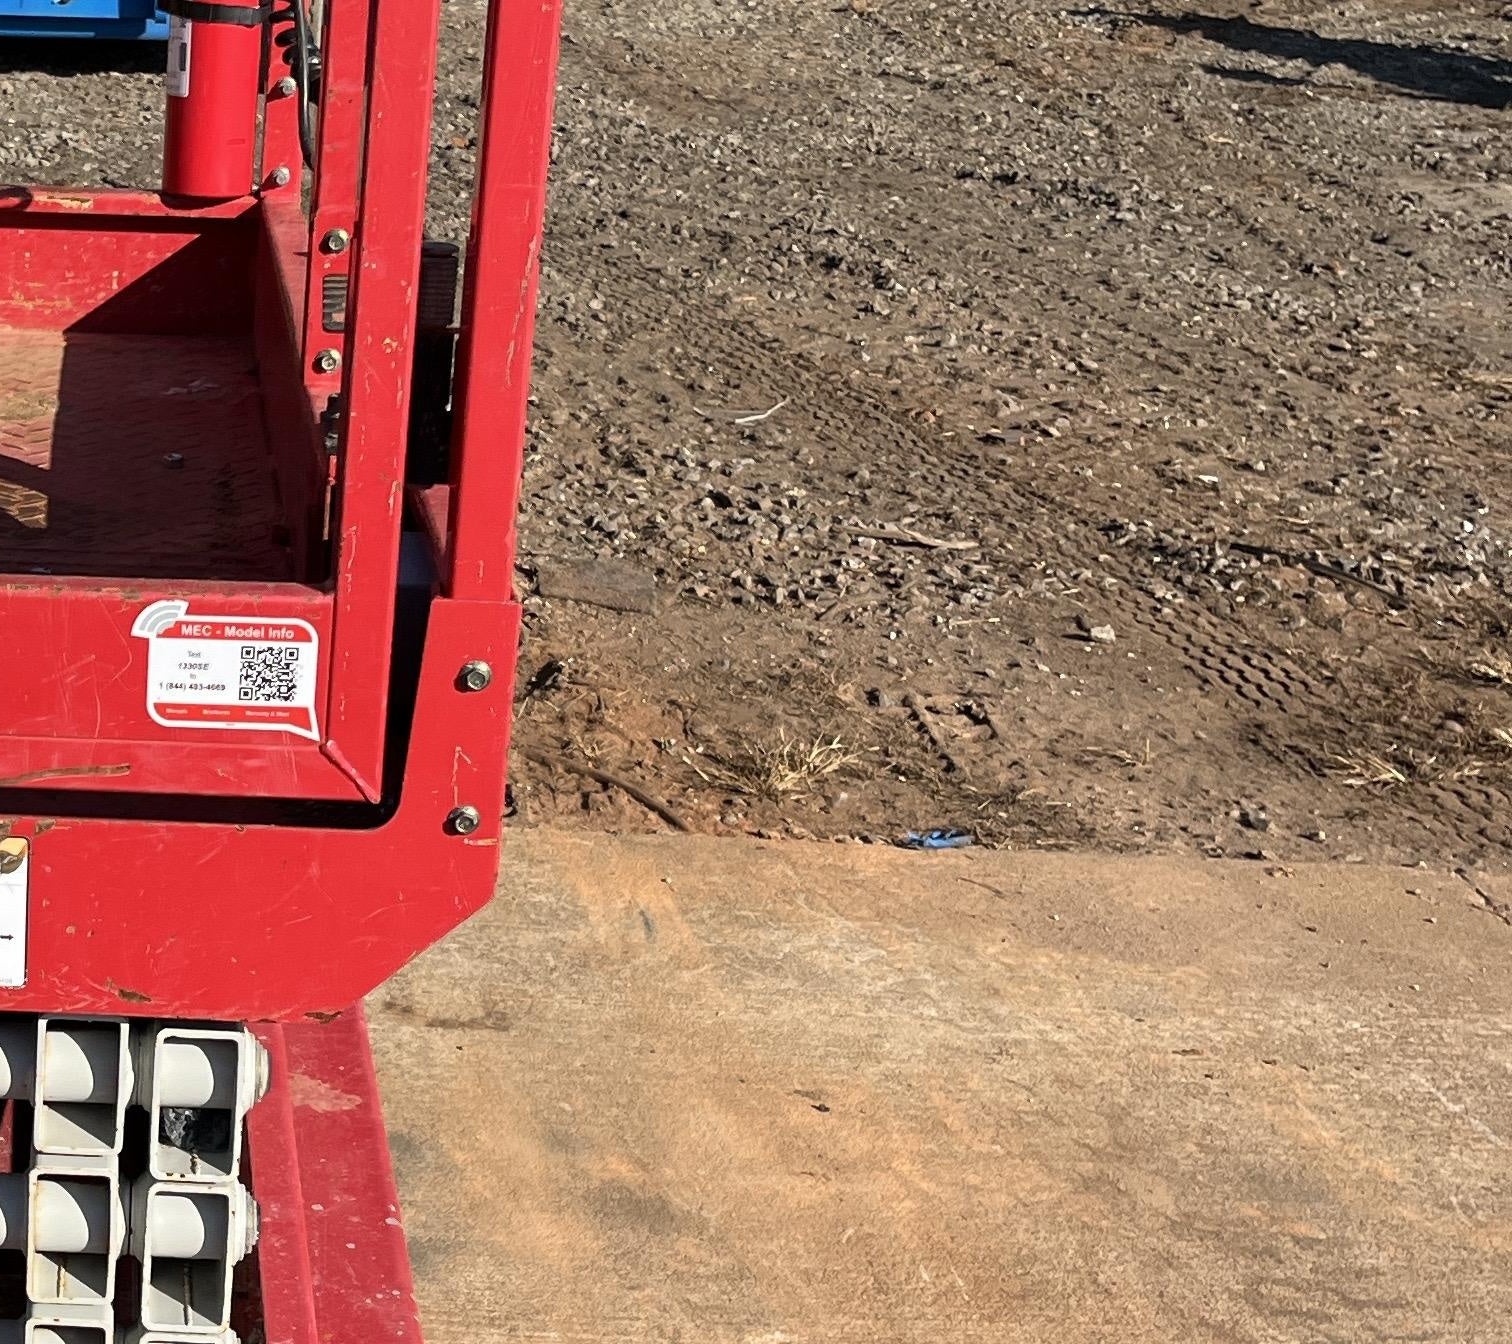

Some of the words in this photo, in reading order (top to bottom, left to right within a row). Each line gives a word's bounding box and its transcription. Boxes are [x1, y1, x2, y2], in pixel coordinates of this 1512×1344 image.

[180, 623, 212, 637] MEC
[224, 626, 265, 639] Model
[268, 627, 295, 640] Info
